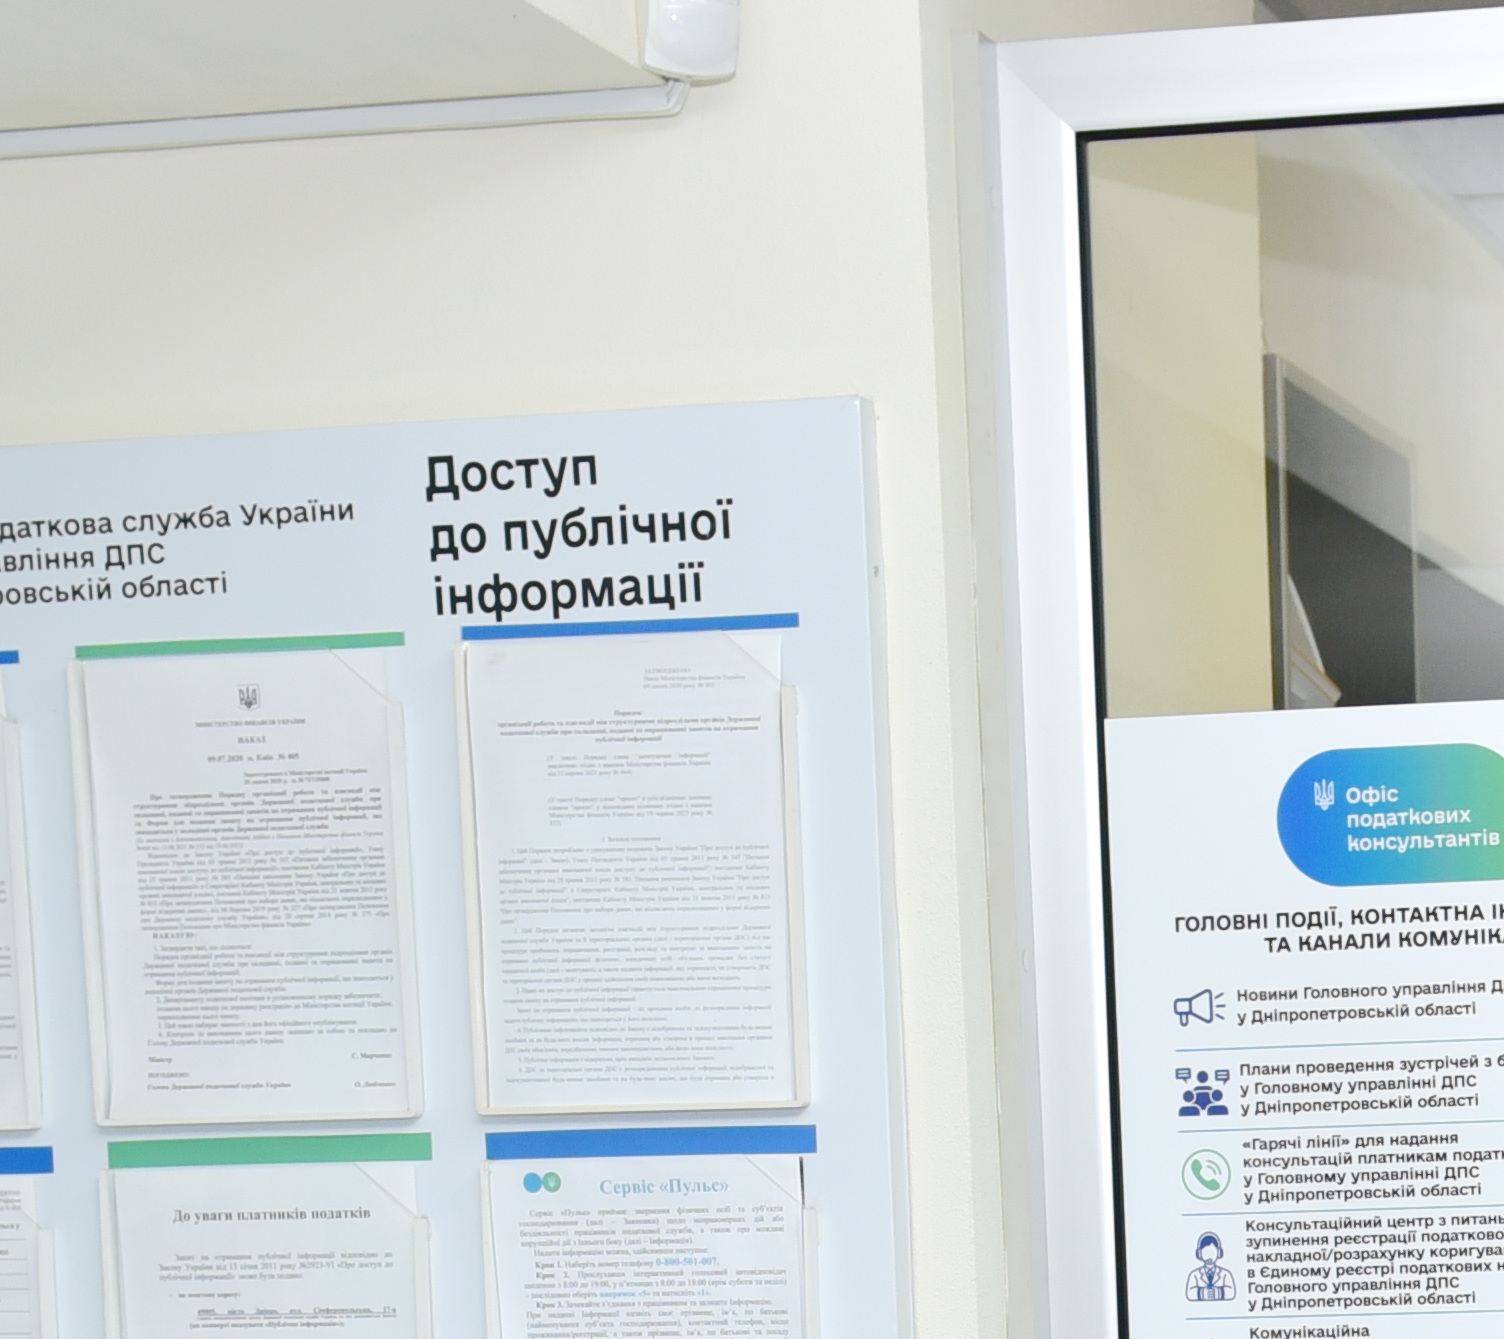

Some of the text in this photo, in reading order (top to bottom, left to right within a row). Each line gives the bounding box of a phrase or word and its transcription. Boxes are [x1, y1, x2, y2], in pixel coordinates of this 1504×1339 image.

[425, 455, 597, 502] Доступ
[122, 505, 231, 537] служба
[240, 499, 354, 530] України
[430, 498, 733, 562] до публічної
[104, 542, 165, 571] ДПС
[121, 571, 227, 599] області
[434, 572, 701, 623] інформації
[1345, 785, 1399, 807] Офіс
[1346, 808, 1471, 832] податкових
[1347, 829, 1501, 853] консультантів
[1175, 913, 1268, 933] ГОЛОВНІ
[1276, 906, 1343, 930] ПОДІЇ,
[1350, 904, 1485, 925] КОНТАКТНА
[1264, 936, 1291, 953] ТА
[1298, 932, 1391, 952] КАНАЛИ
[1237, 989, 1298, 1002] Новини
[1303, 986, 1388, 1000] Головного
[1392, 980, 1486, 999] управління
[1237, 1001, 1476, 1027] у Дніпропетровській області
[1239, 1063, 1291, 1076] Плани
[1296, 1060, 1394, 1077] проведення
[1399, 1054, 1479, 1073] зустрічей
[1484, 1057, 1492, 1068] з
[1240, 1074, 1477, 1098] у Головному управлінні ДПС
[1240, 1093, 1479, 1117] у Дніпропетровській області
[1242, 1134, 1459, 1153] «Гарячі лінії» для надання
[1243, 1152, 1353, 1170] консультацій
[1358, 1151, 1448, 1164] платникам
[599, 1178, 729, 1198] Сервіс «Пульс»
[1243, 1165, 1480, 1189] у Головному управлінні ДПС
[1244, 1182, 1481, 1206] у Дніпропетровській області
[172, 1206, 371, 1225] До уваги платників податків
[1245, 1215, 1382, 1234] Консультаційний
[1387, 1217, 1434, 1230] центр
[1438, 1216, 1447, 1227] з
[1246, 1236, 1329, 1251] зупинення
[1333, 1230, 1417, 1248] реєстрації
[1246, 1248, 1425, 1263] накладної/розрахунку
[1247, 1269, 1256, 1278] в
[1259, 1266, 1331, 1280] Єдиному
[1336, 1262, 1394, 1279] реєстрі
[1399, 1262, 1492, 1275] податкових
[1248, 1276, 1460, 1295] Головного управління ДПС
[1248, 1290, 1476, 1312] у Дніпропетровській області
